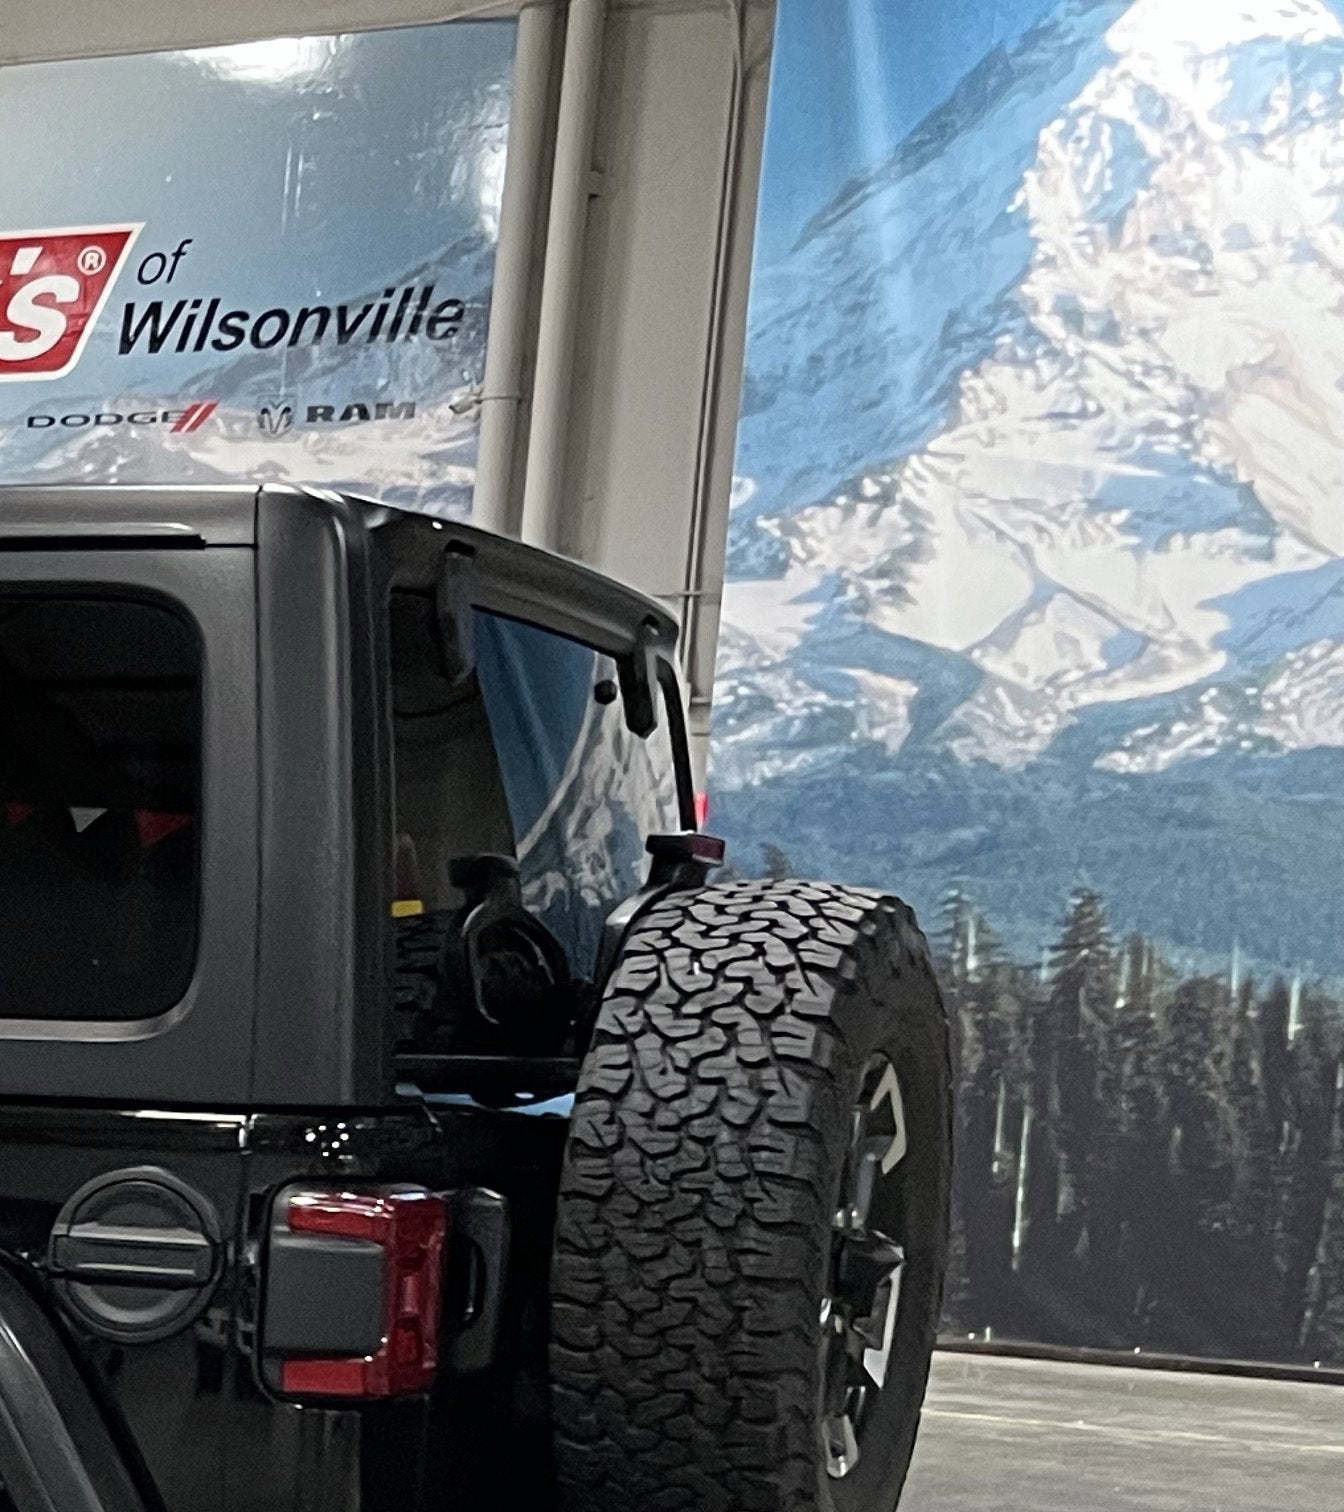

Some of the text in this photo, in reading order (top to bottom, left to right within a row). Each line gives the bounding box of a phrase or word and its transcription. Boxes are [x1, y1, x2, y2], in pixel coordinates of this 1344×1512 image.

[137, 238, 193, 286] of
[117, 285, 465, 356] Wilsonville
[26, 410, 185, 429] DODGE
[305, 401, 417, 424] RAM
